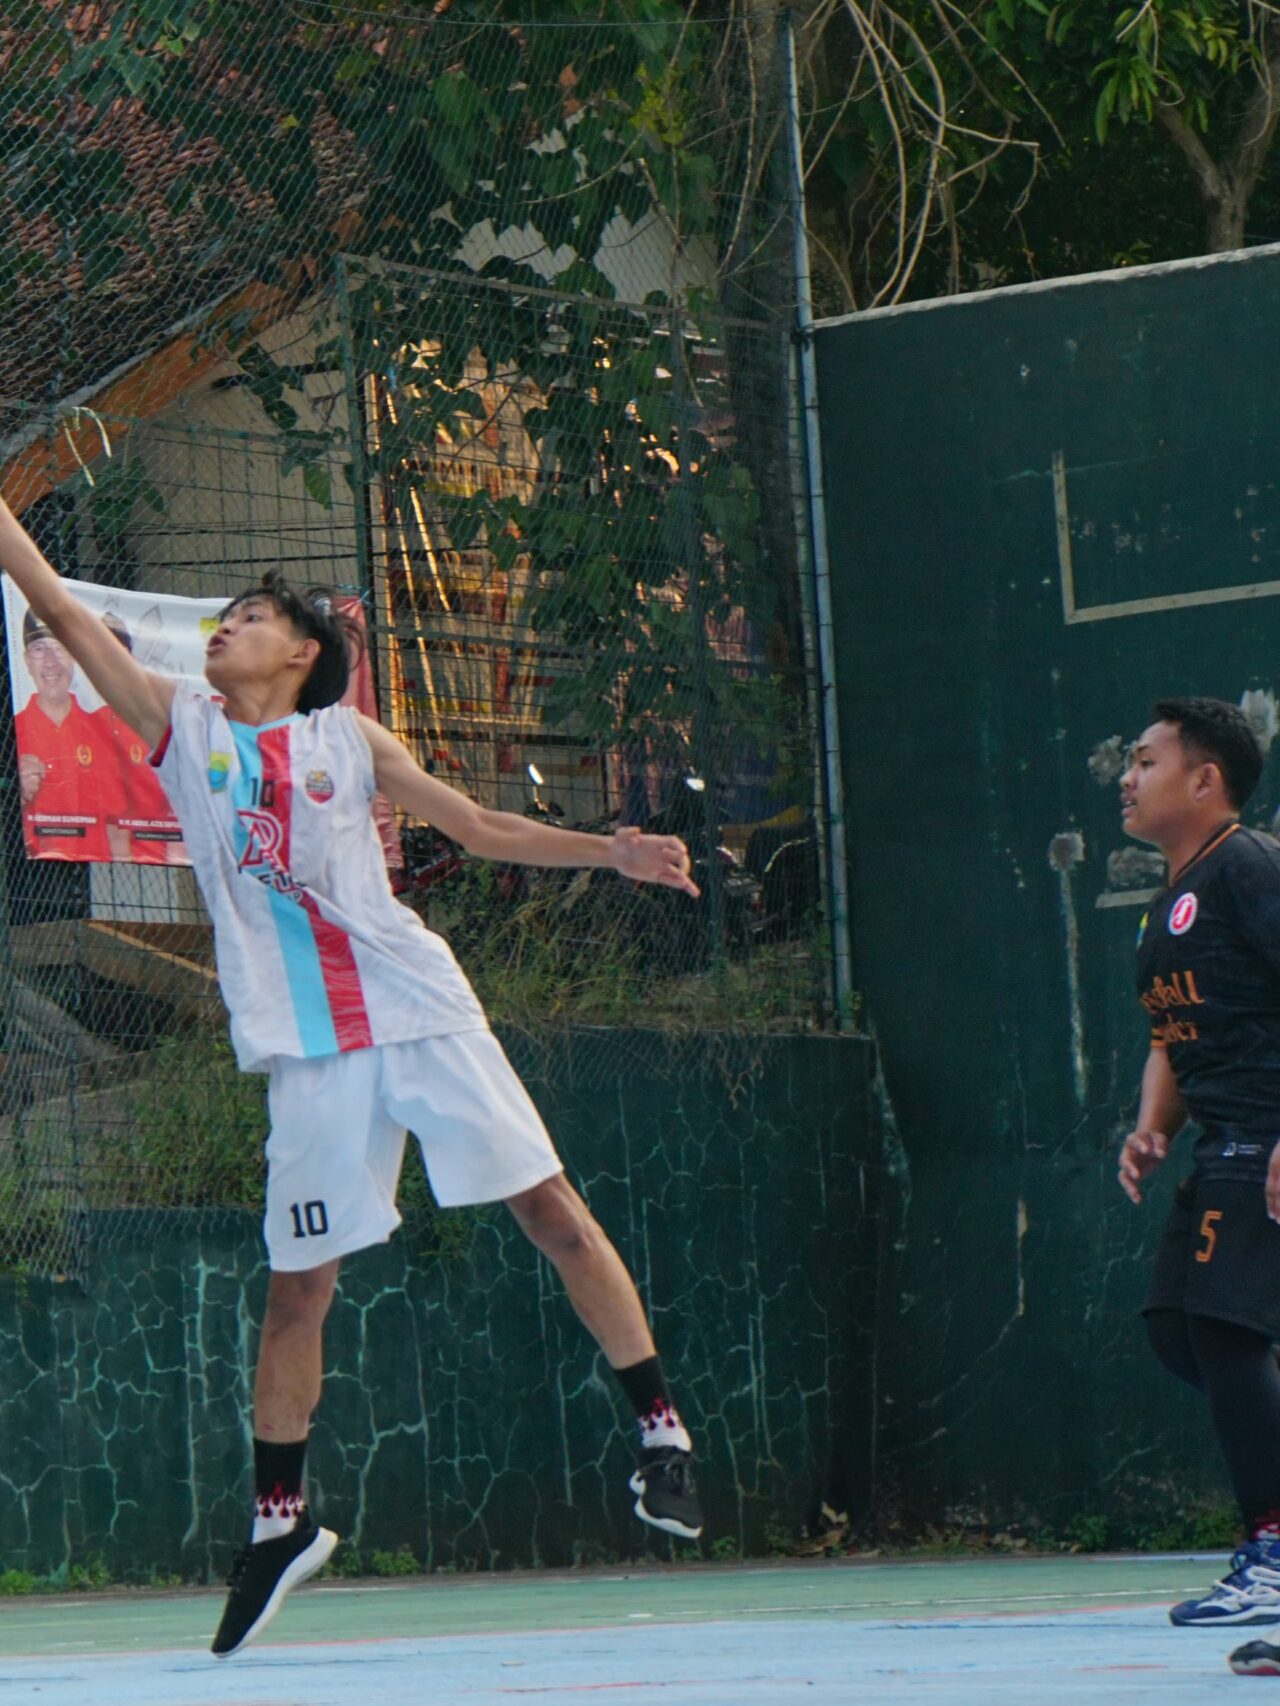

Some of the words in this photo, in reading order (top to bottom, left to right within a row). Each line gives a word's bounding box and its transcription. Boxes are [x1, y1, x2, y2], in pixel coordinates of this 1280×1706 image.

[250, 776, 276, 807] 10
[289, 1199, 329, 1238] 10
[1194, 1210, 1224, 1264] 5
